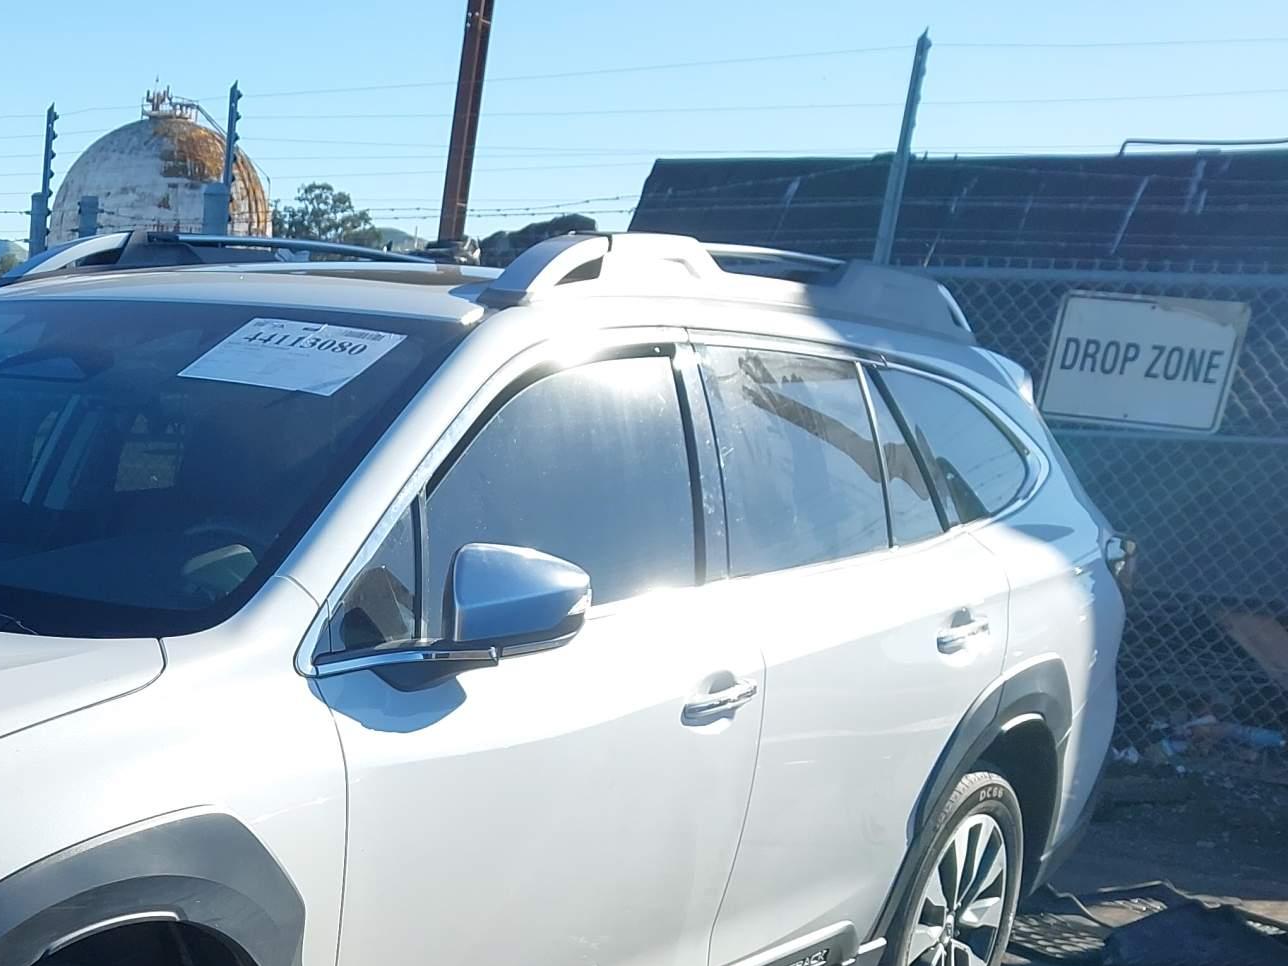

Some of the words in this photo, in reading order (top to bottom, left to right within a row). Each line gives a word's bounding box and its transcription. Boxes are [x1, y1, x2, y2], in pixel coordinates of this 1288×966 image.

[243, 331, 367, 355] 44113080
[1059, 337, 1141, 376] DROP
[1144, 345, 1225, 384] ZONE
